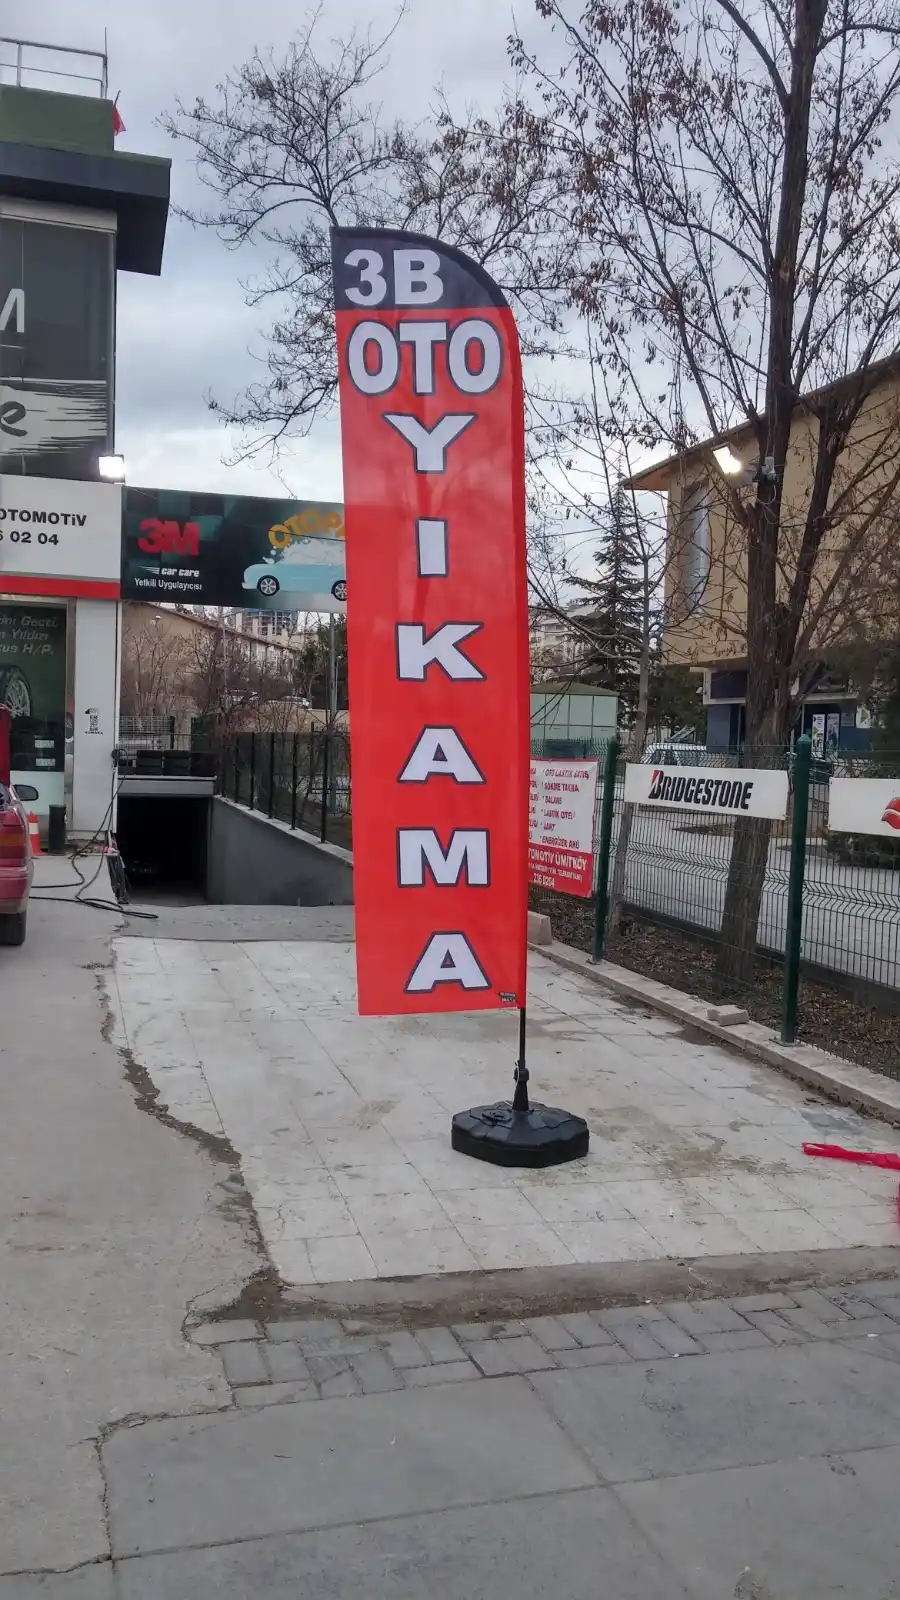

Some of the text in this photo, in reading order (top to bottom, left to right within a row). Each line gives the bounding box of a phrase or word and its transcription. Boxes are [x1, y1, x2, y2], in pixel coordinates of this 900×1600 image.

[343, 248, 444, 306] 3B
[347, 318, 504, 397] OTO
[9, 530, 32, 544] 02
[37, 532, 59, 546] 04
[137, 517, 200, 556] 3M
[268, 509, 346, 549] OTOP
[161, 567, 200, 578] car care
[381, 411, 491, 993] YIKAMA
[648, 769, 754, 810] BRIDGESTONE
